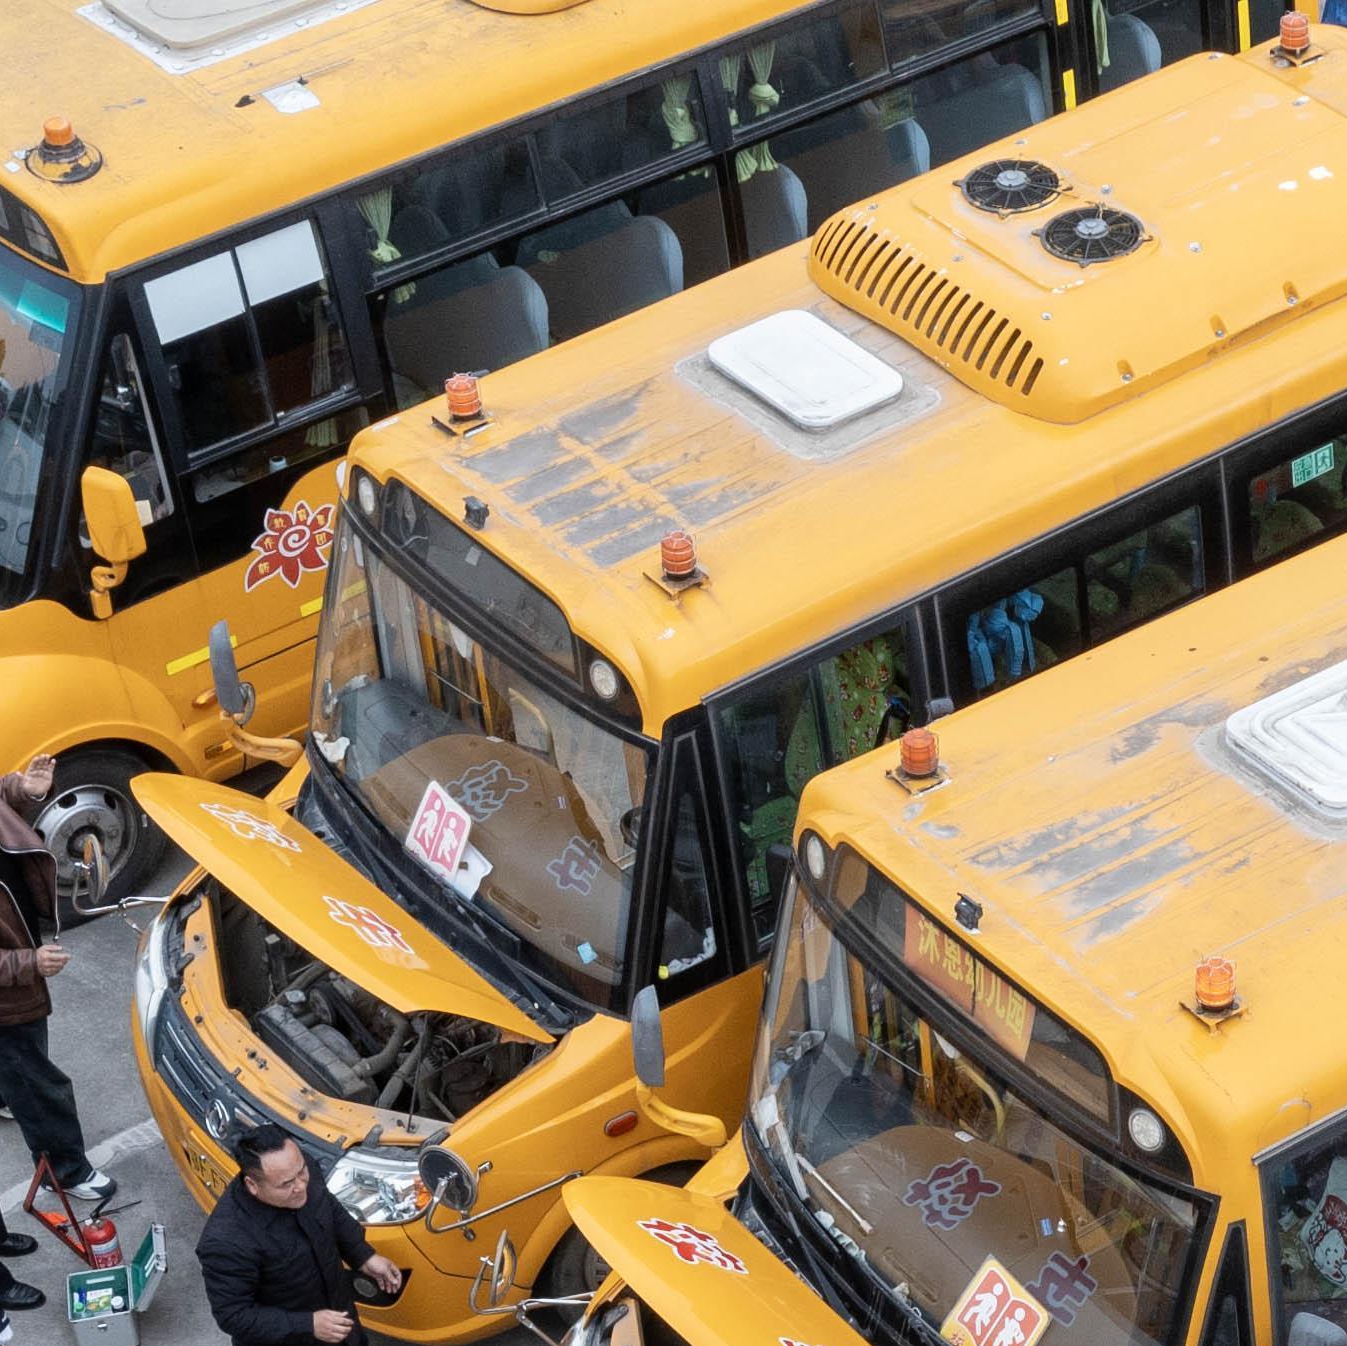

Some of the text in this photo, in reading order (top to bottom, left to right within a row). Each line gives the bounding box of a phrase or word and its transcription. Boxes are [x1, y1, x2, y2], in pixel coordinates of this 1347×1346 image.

[199, 802, 415, 955] 校车
[919, 913, 1026, 1040] 沐恩幼儿园
